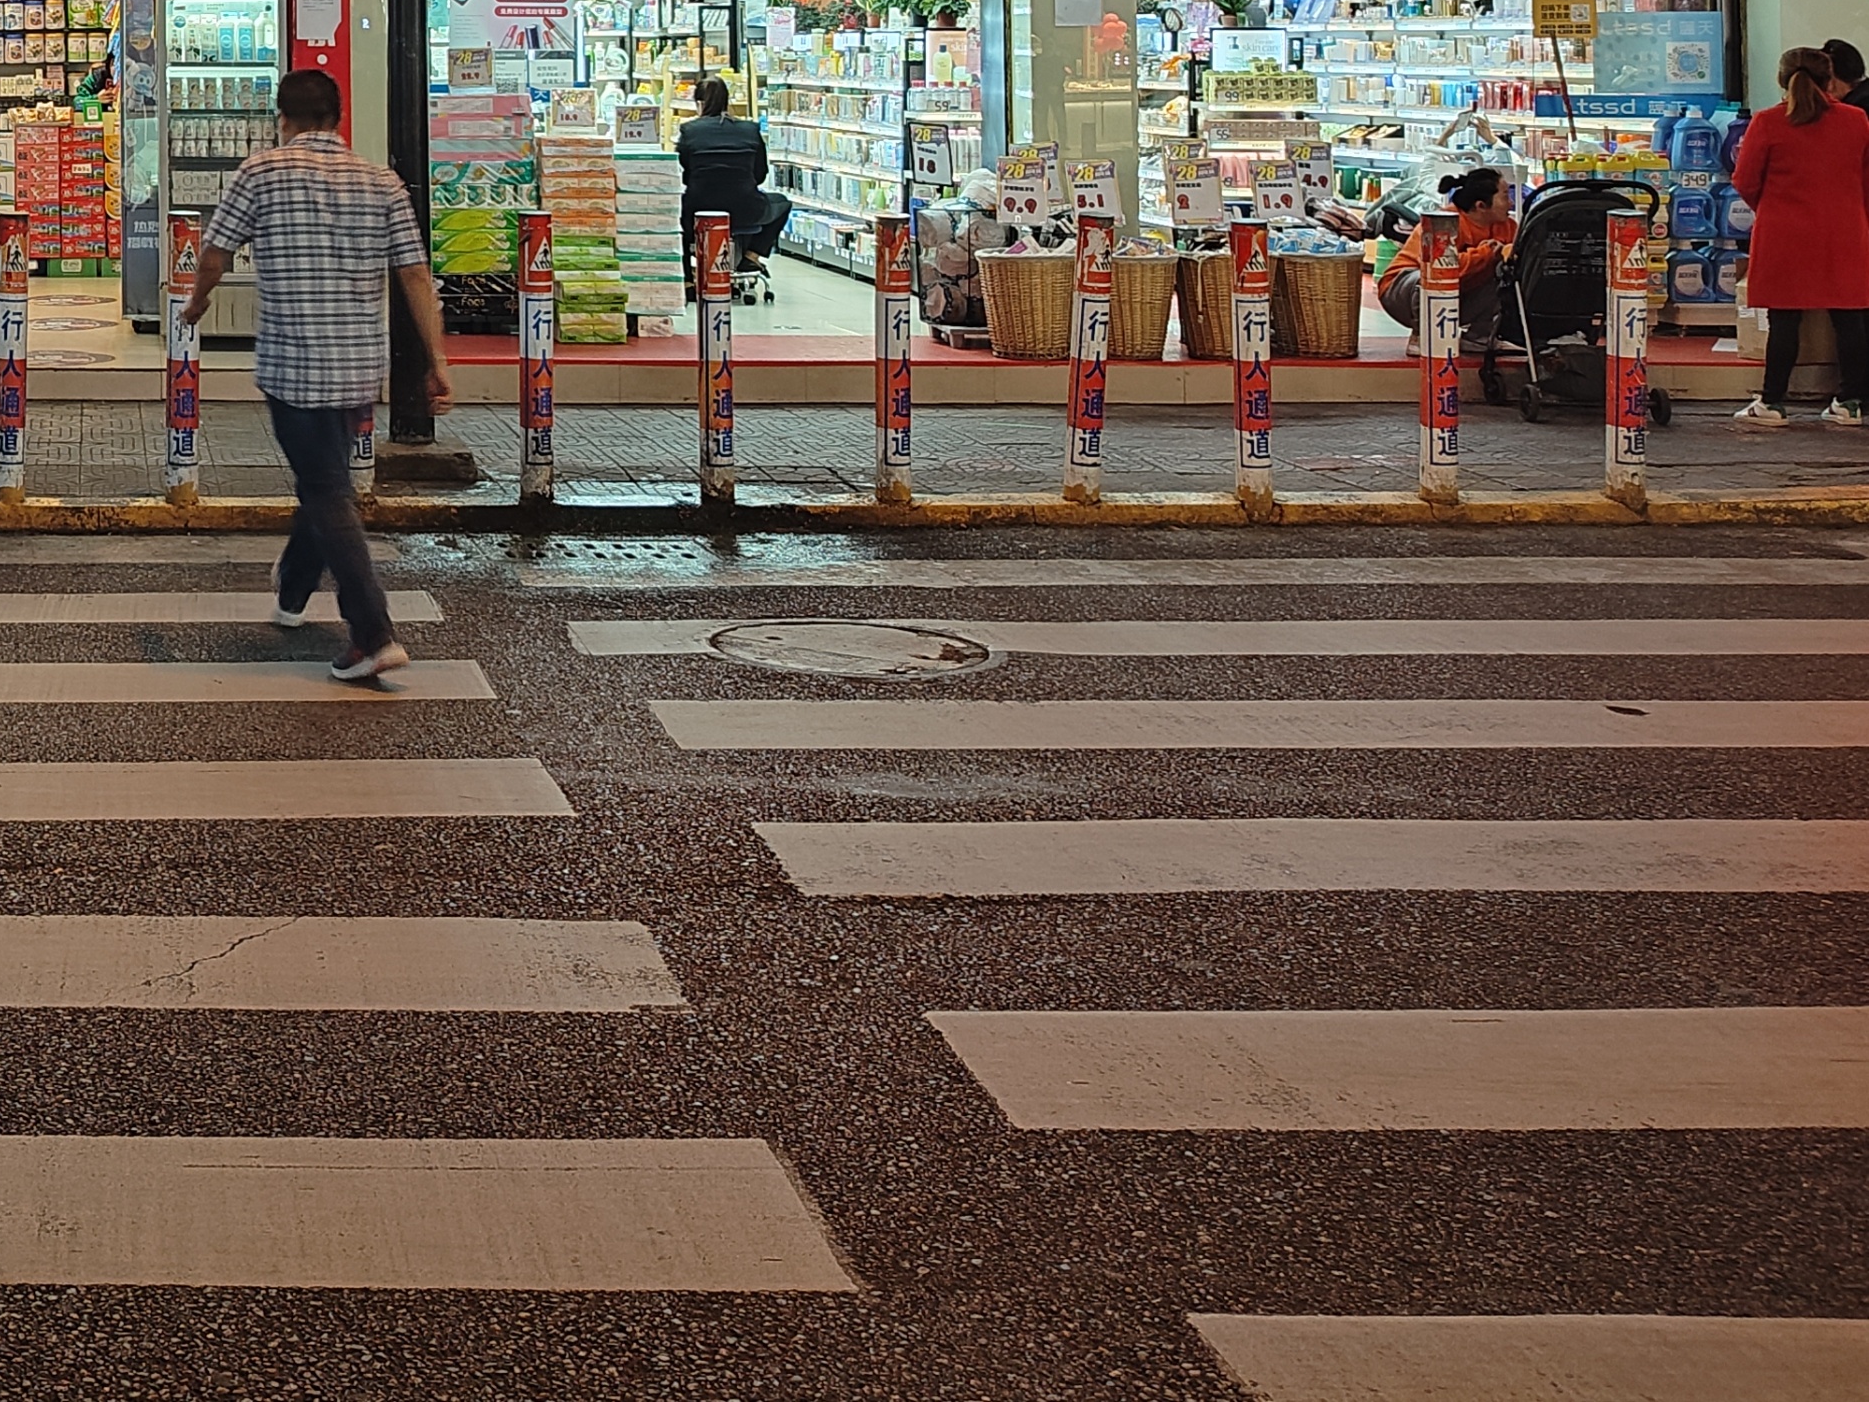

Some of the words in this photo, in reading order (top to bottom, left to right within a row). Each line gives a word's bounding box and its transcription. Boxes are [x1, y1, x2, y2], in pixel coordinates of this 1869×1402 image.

[915, 128, 931, 142] 28
[1292, 146, 1311, 160] 28
[1004, 164, 1025, 179] 28
[1075, 166, 1095, 181] 28
[1176, 165, 1198, 180] 28
[1256, 166, 1276, 181] 28
[1003, 196, 1038, 214] 9.9
[1262, 193, 1294, 210] 1.9
[532, 310, 553, 457] 行人通道
[1242, 310, 1272, 460] 行人通道
[1435, 307, 1459, 457] 行人通道
